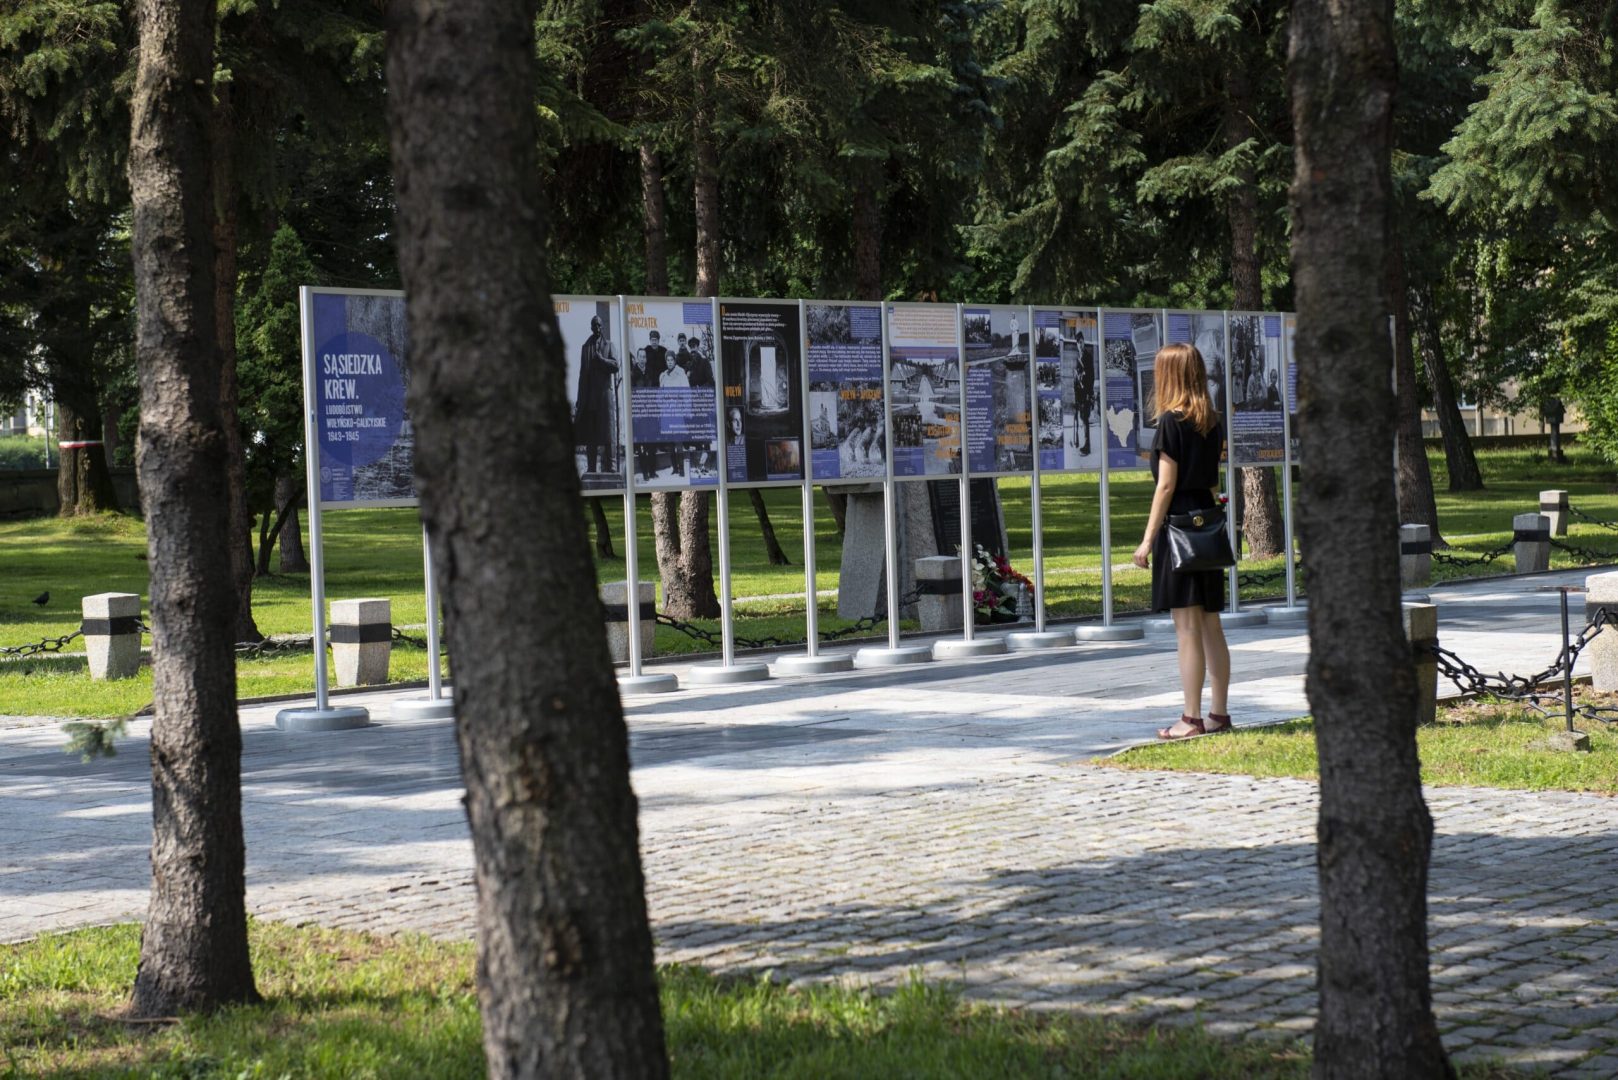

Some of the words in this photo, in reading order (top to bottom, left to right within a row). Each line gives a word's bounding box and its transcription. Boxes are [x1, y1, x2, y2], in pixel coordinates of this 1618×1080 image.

[324, 353, 382, 378] SĄSIEDZKA
[325, 379, 359, 400] KREW.
[325, 402, 363, 415] LUDOBÓJSTWO
